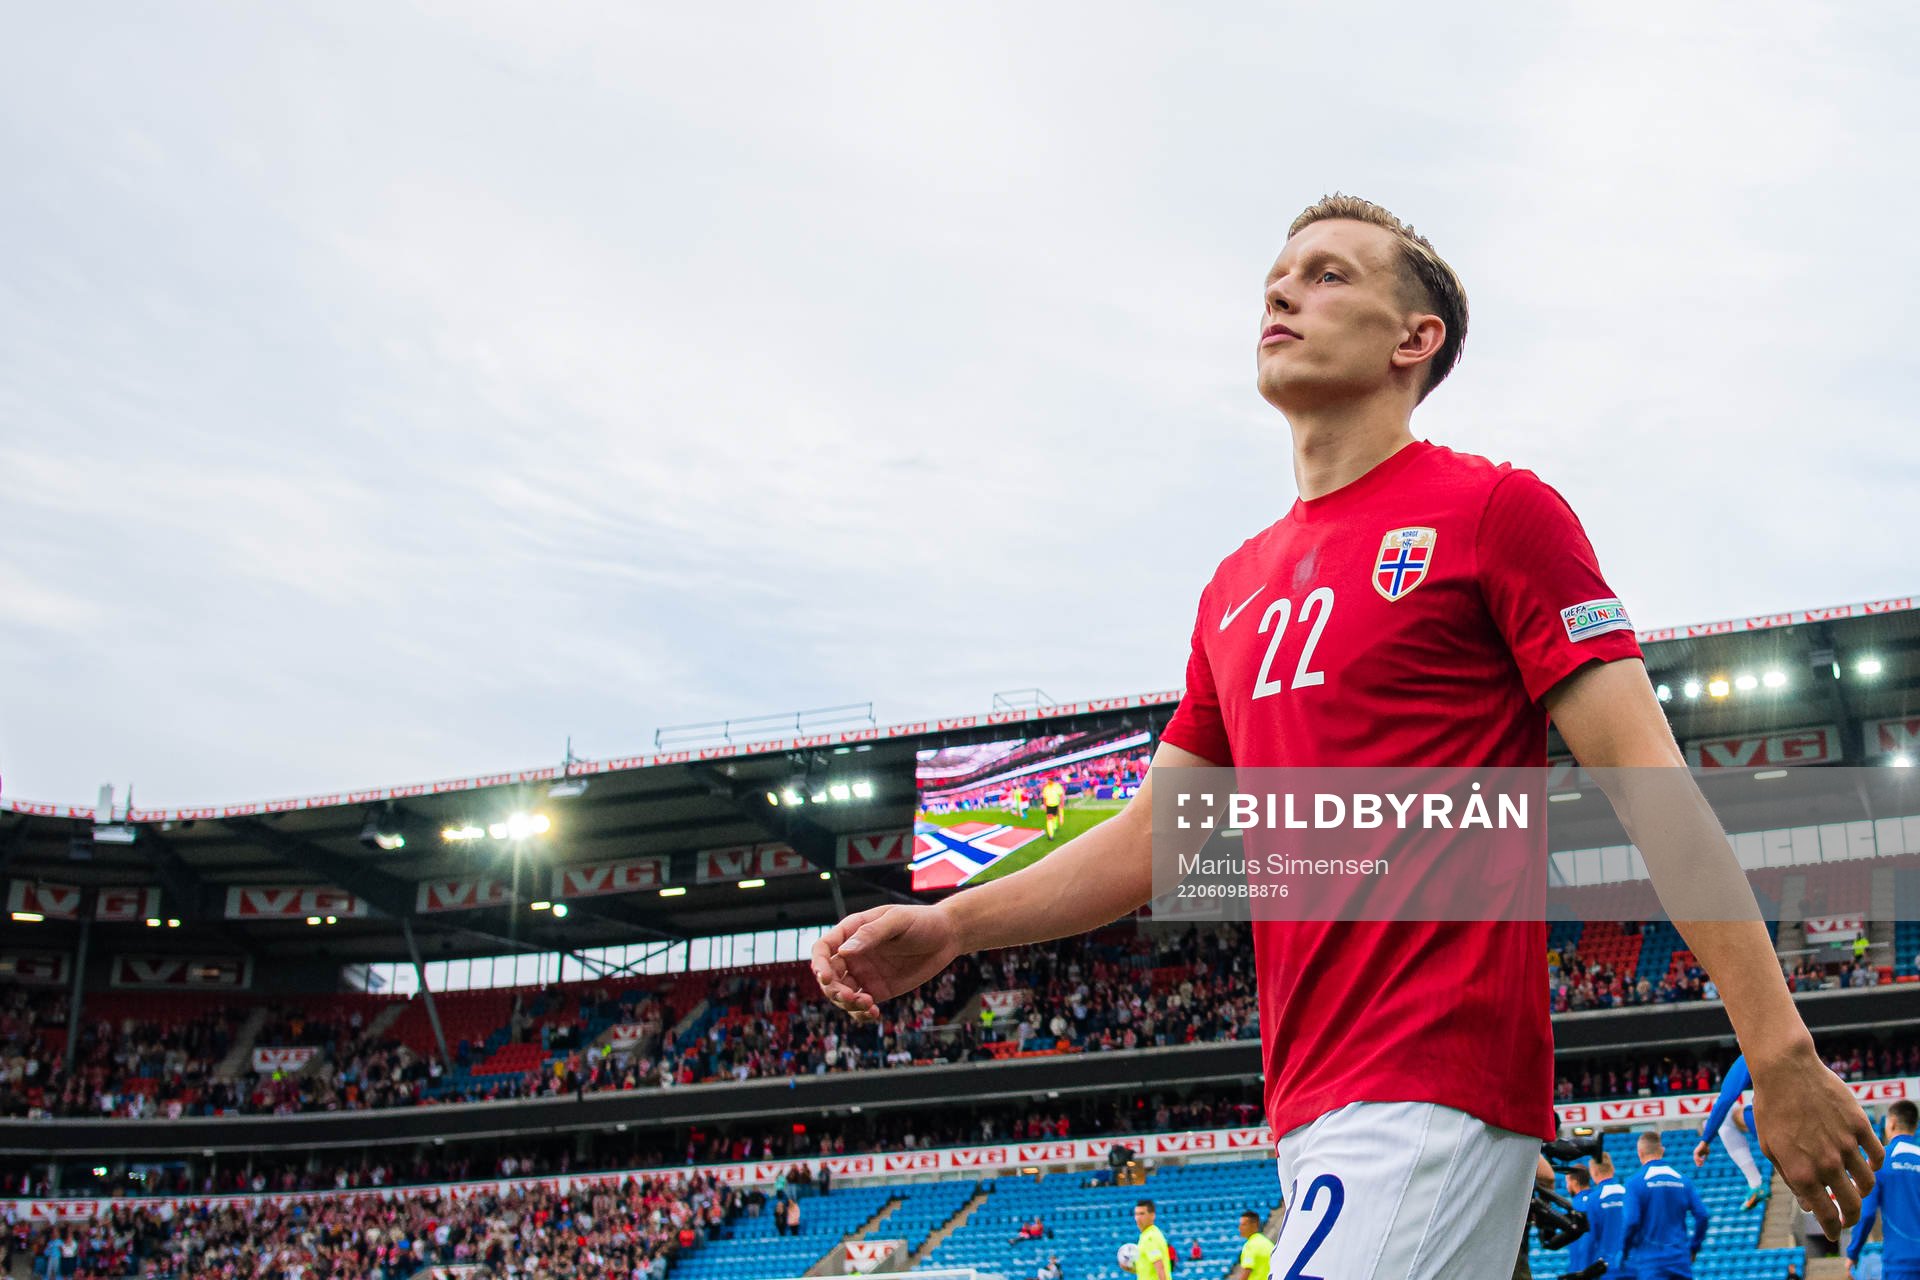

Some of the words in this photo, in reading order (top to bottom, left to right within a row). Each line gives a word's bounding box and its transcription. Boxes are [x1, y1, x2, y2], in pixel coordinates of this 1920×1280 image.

[1564, 606, 1587, 618] UEFA
[1252, 586, 1335, 700] 22
[1702, 732, 1823, 767] VG
[708, 846, 805, 877] VG
[564, 864, 657, 896] VG
[240, 888, 355, 915] VG
[1807, 918, 1863, 932] VG
[1602, 1101, 1664, 1119] VG
[885, 1153, 939, 1170] VG
[952, 1148, 1007, 1166] VG
[1019, 1143, 1075, 1161] VG
[1157, 1134, 1215, 1152] VG
